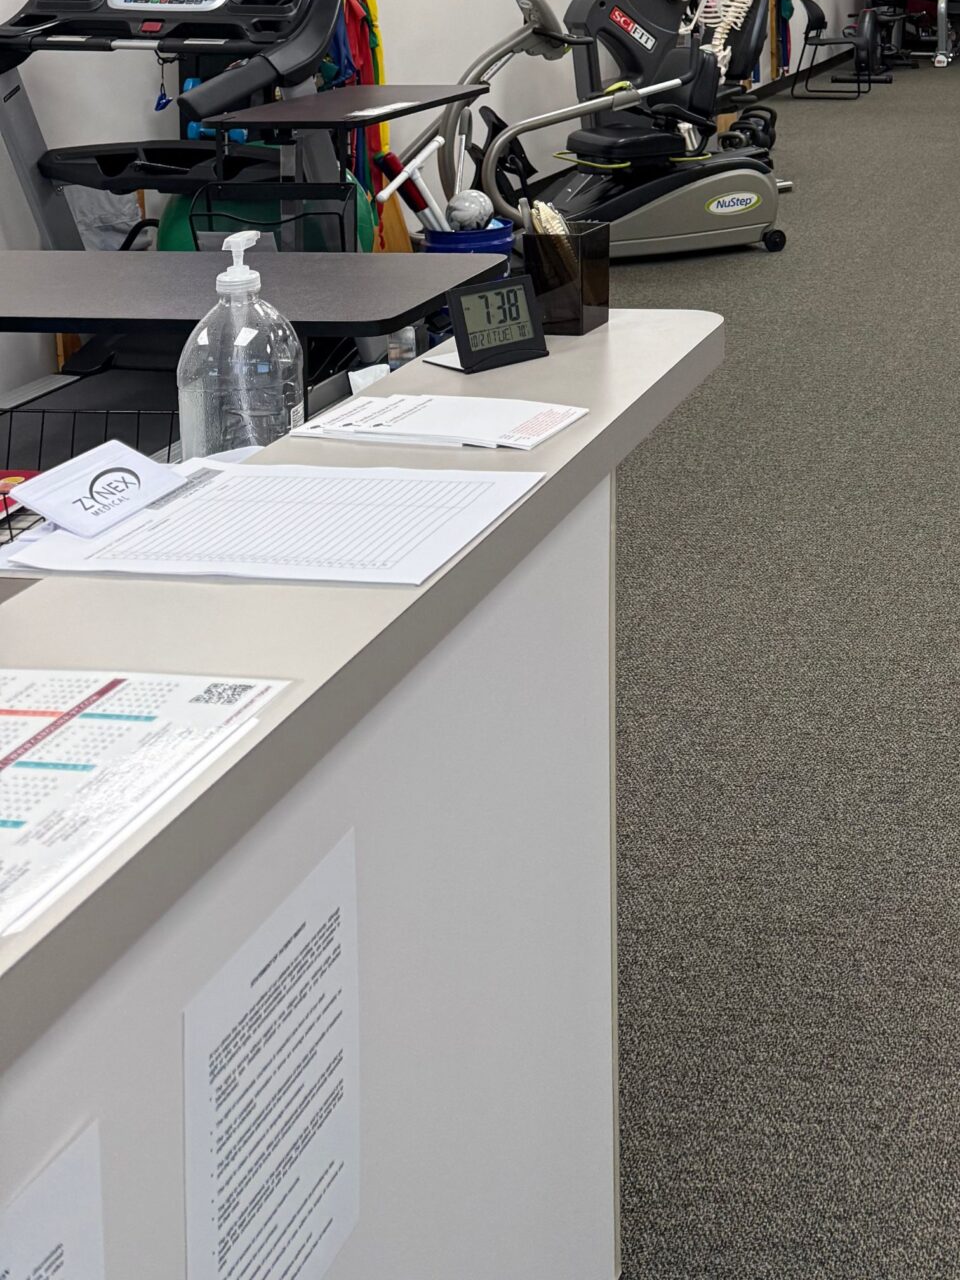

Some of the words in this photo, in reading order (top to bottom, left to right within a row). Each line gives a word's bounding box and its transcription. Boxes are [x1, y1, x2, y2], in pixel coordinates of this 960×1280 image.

[612, 10, 653, 45] SCIFIT
[716, 197, 752, 209] NuStep
[478, 289, 520, 325] 7:38
[72, 476, 137, 512] ZYNEX
[91, 496, 130, 517] MEDICAL
